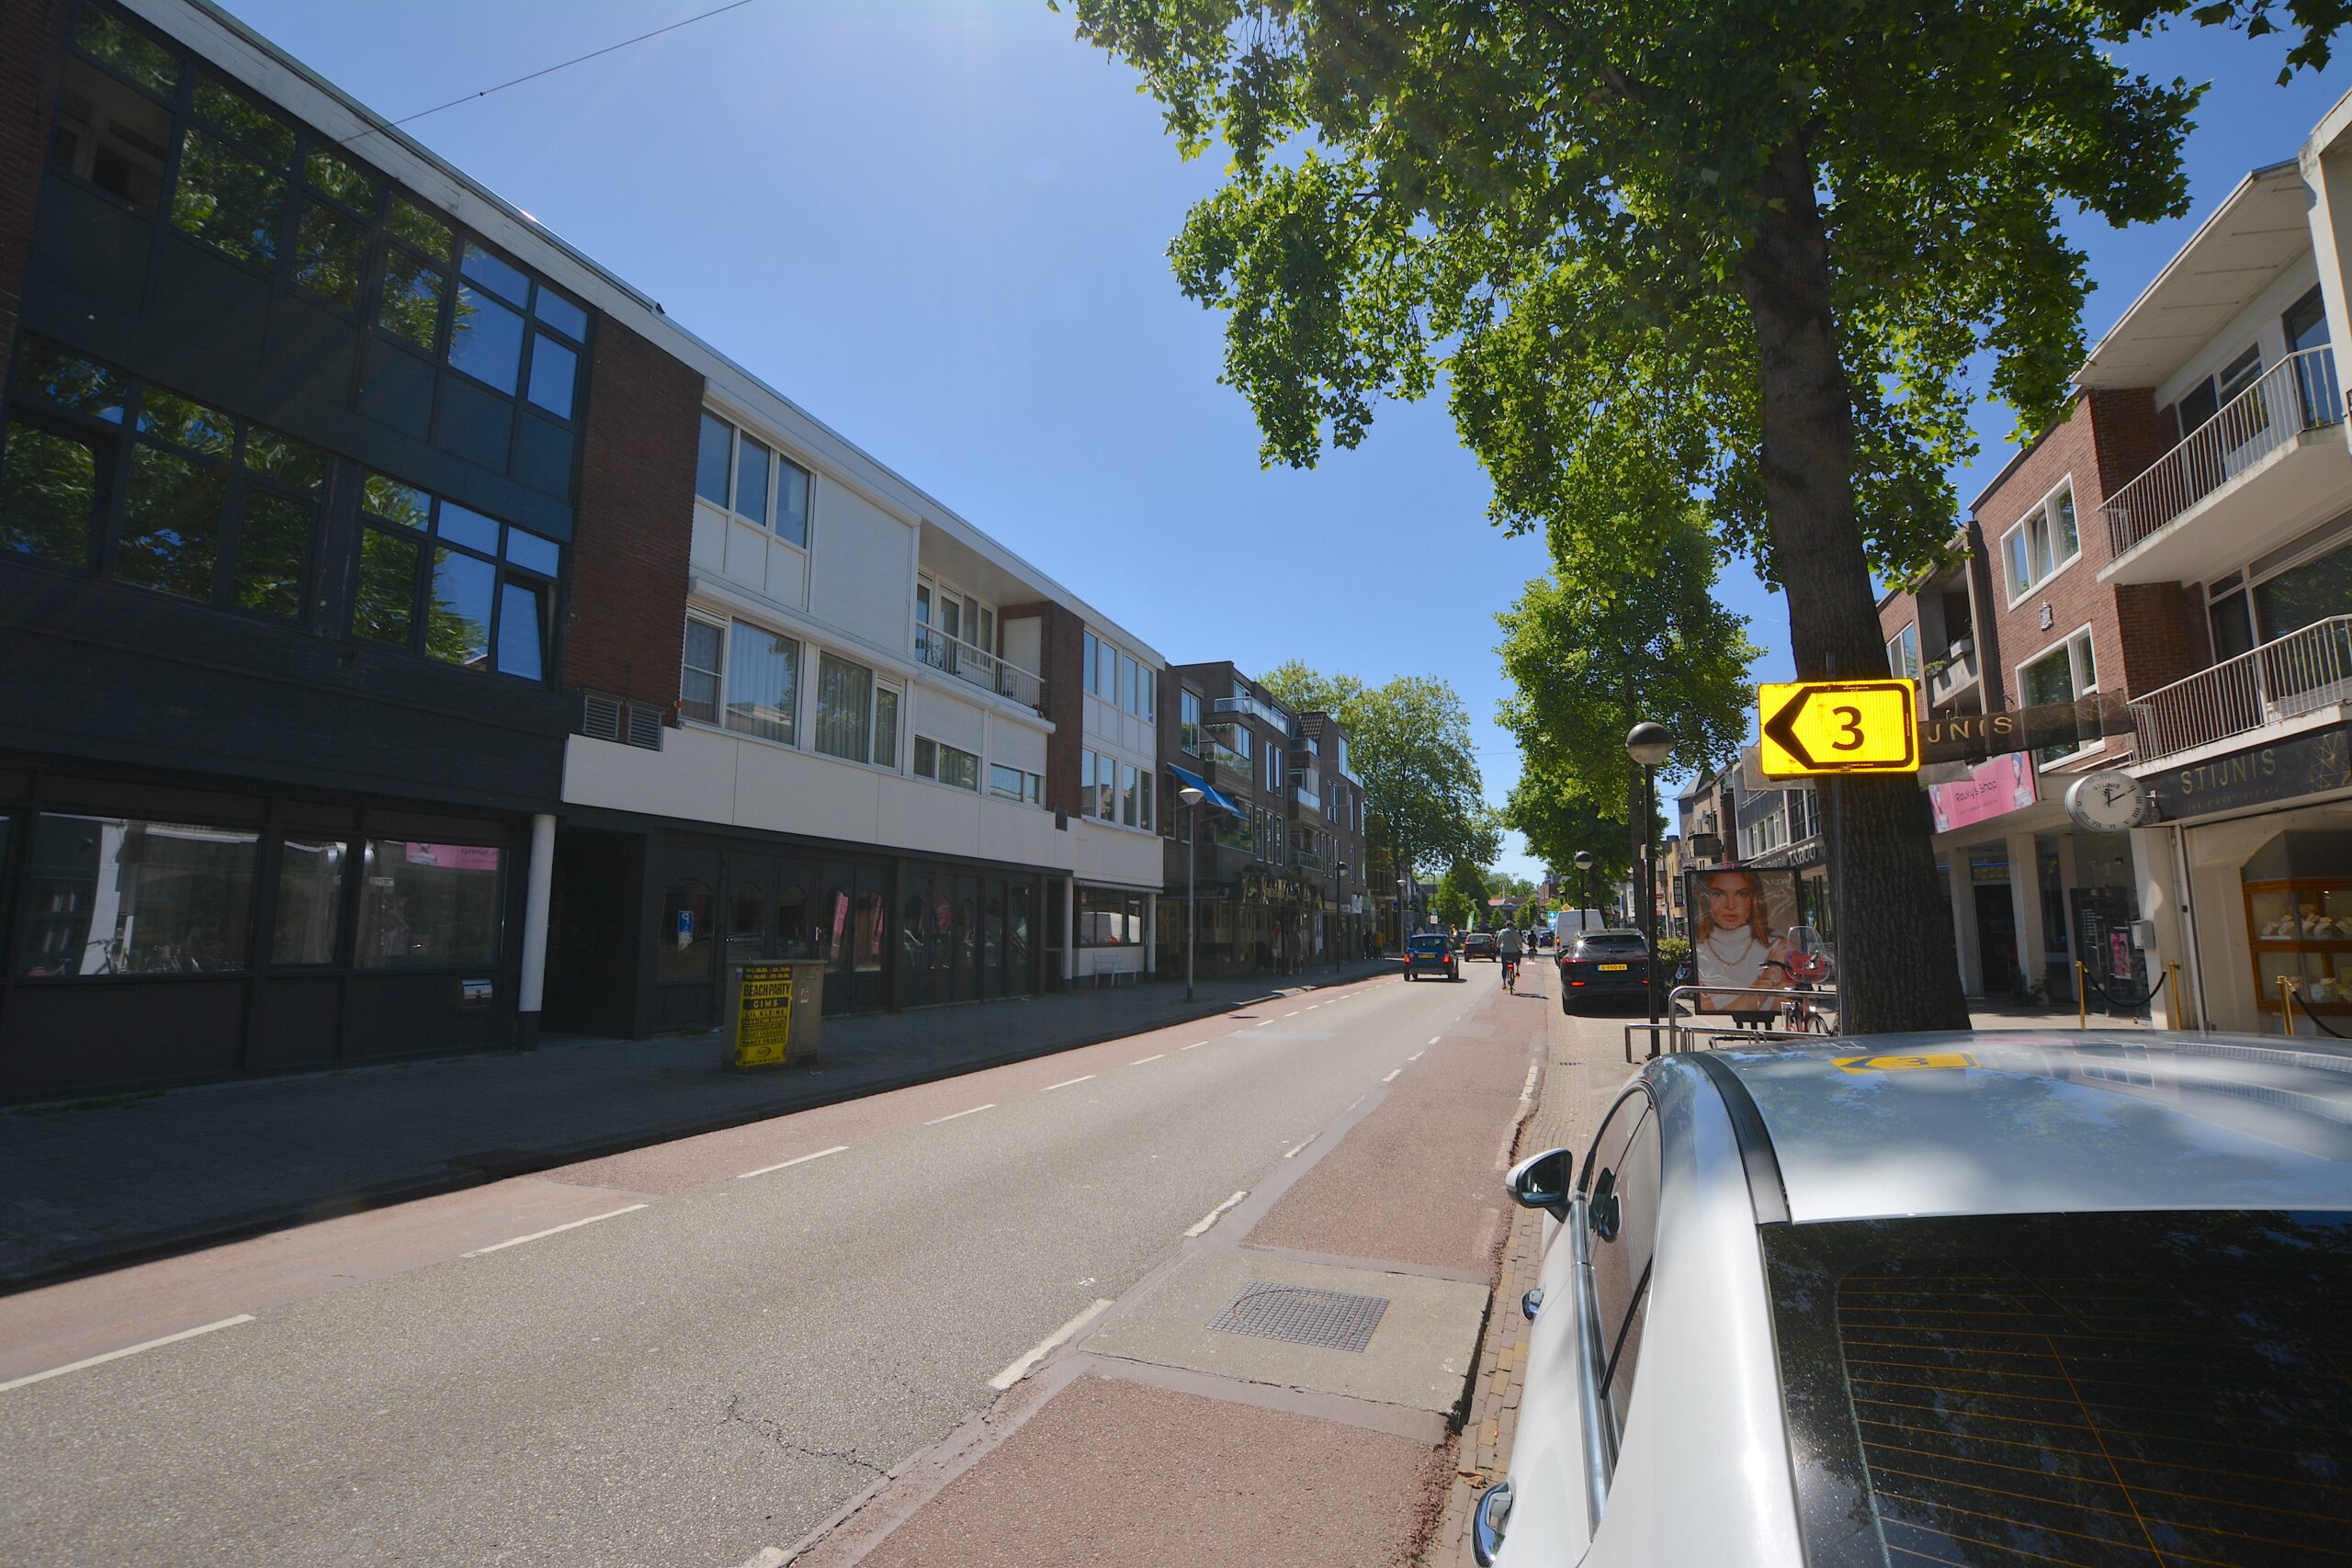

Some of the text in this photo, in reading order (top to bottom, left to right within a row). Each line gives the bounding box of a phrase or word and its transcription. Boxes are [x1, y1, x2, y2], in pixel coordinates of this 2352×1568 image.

[1832, 705, 1865, 750] 3
[1928, 716, 2013, 743] JNIS
[2180, 748, 2277, 795] STIJNIS
[1788, 842, 1816, 867] TABOO
[752, 998, 778, 1009] GIMS
[760, 1009, 786, 1017] KLEINE
